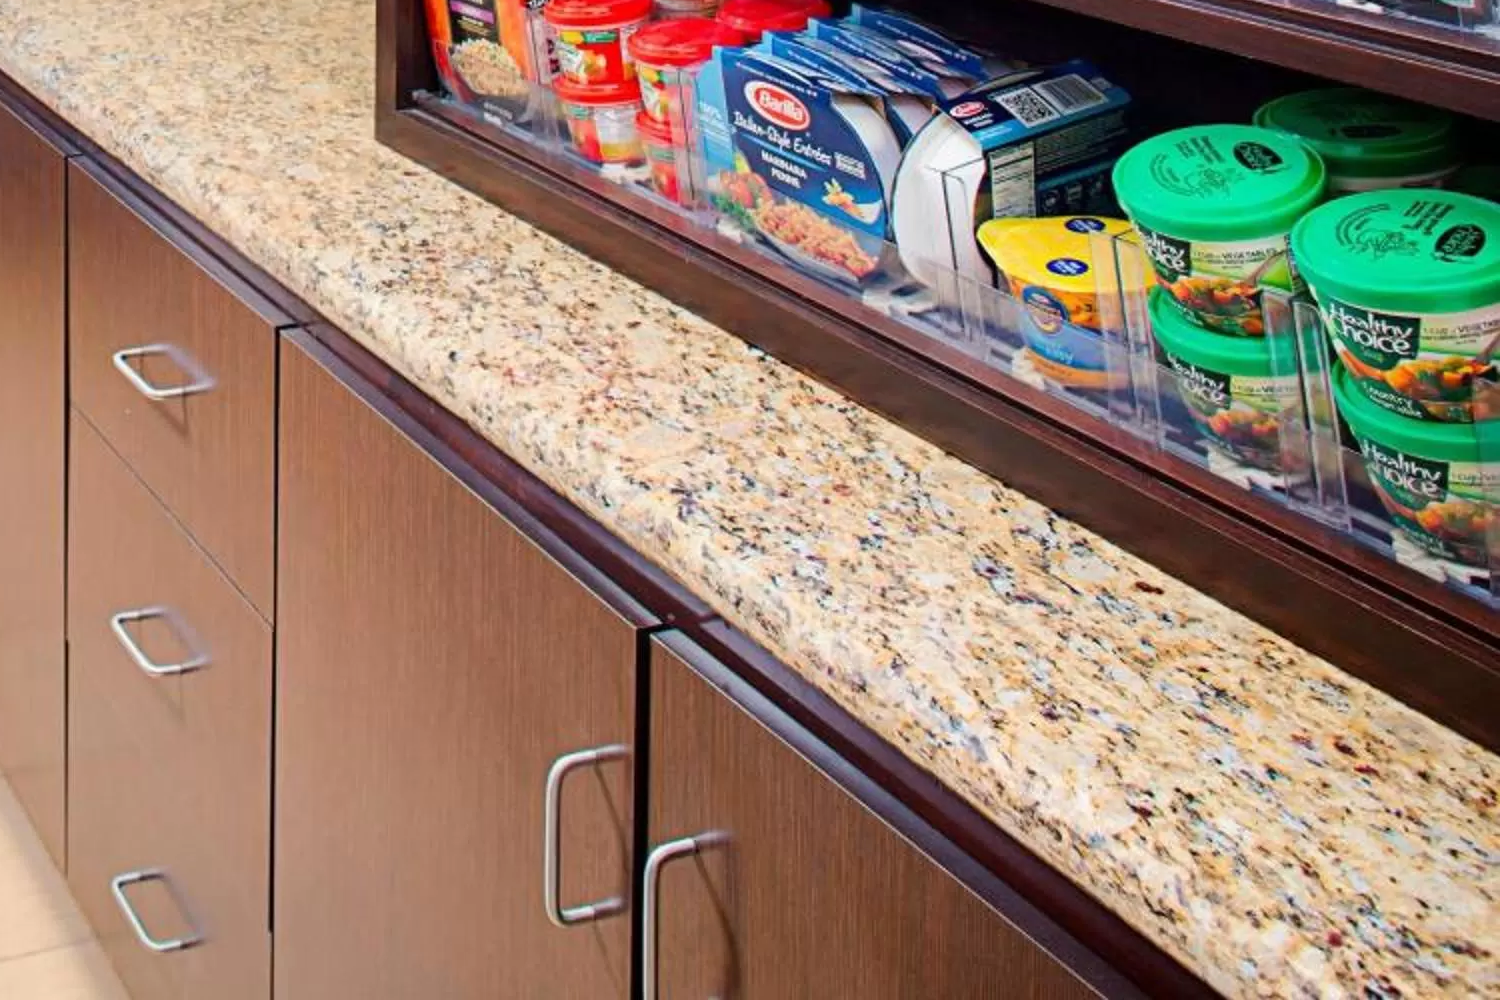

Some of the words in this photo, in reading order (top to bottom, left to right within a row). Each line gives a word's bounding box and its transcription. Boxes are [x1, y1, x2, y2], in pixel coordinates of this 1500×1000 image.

[758, 89, 805, 122] Barilla
[1330, 303, 1414, 340] Healthy
[1362, 438, 1442, 482] Healthy
